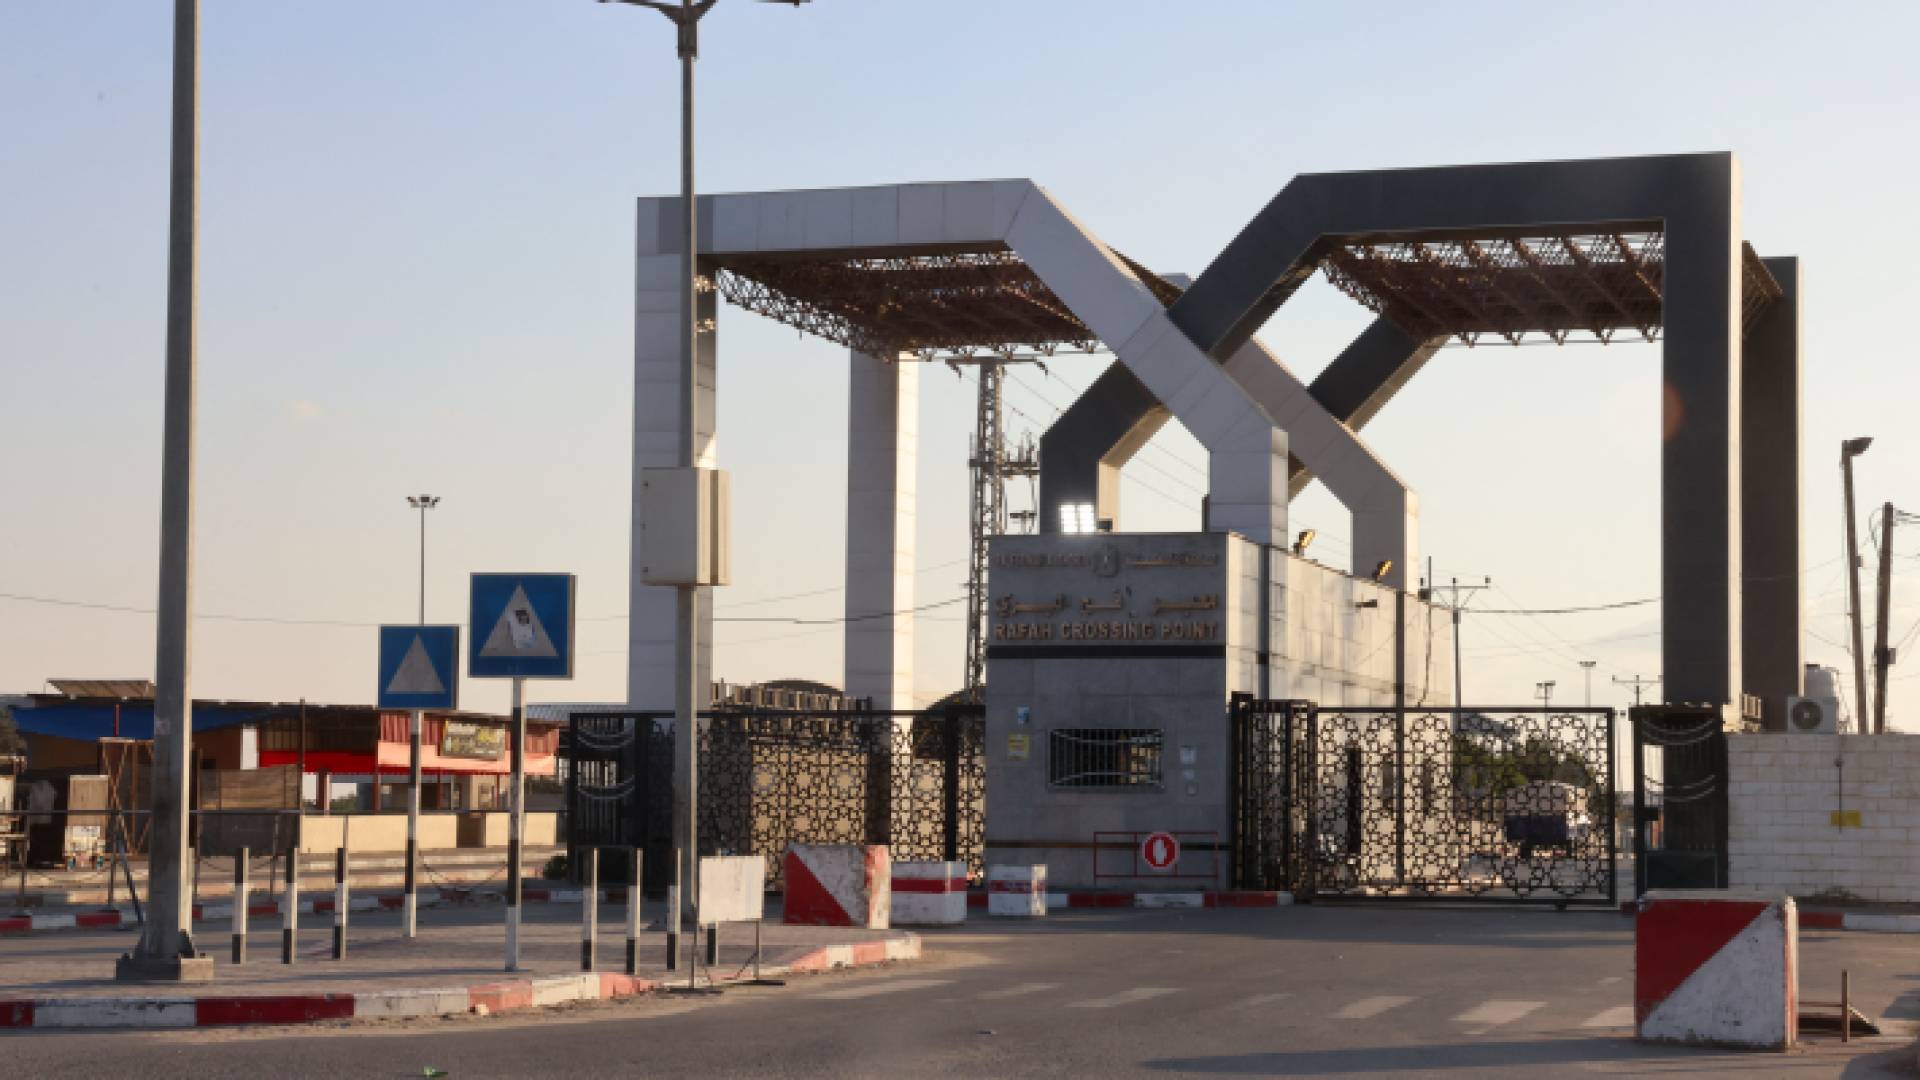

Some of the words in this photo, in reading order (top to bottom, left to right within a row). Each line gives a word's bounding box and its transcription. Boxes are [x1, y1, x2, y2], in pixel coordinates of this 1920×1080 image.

[995, 623, 1052, 641] RAFAH
[1061, 623, 1154, 641] CROSSING
[1161, 623, 1218, 641] POINT
